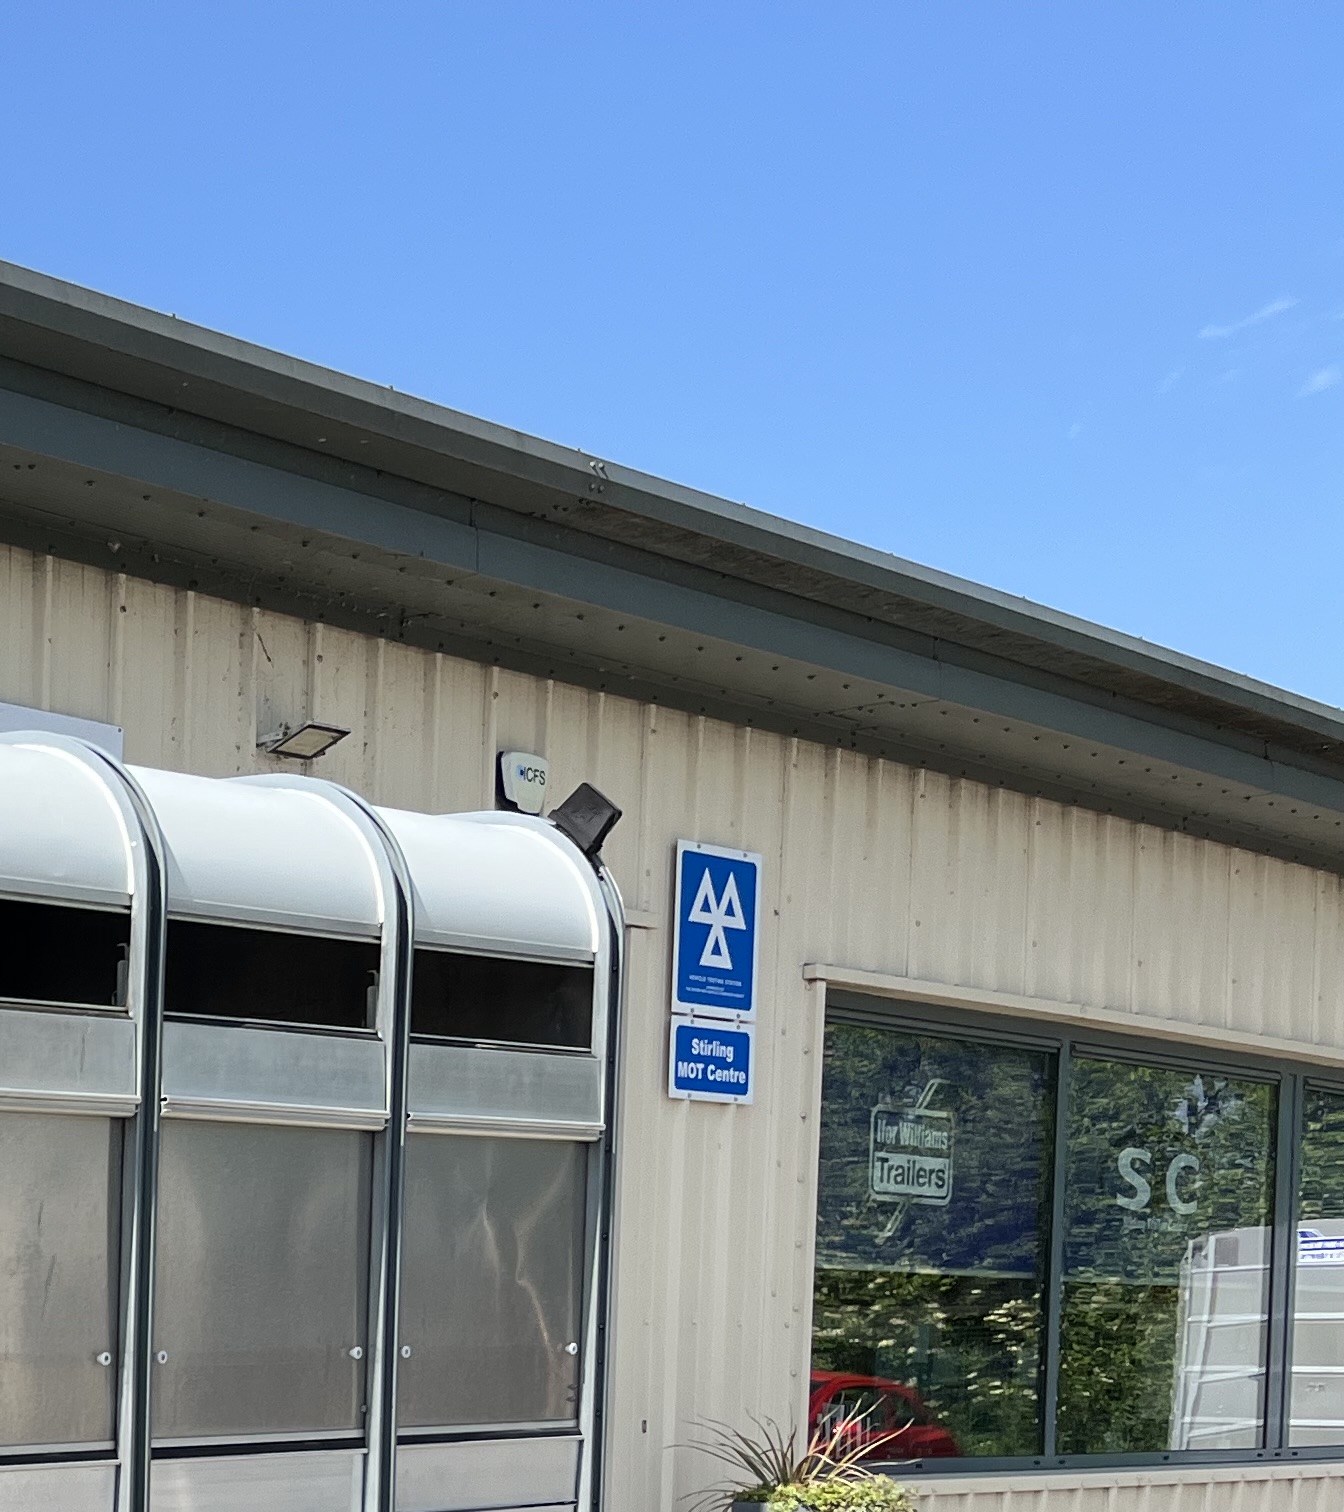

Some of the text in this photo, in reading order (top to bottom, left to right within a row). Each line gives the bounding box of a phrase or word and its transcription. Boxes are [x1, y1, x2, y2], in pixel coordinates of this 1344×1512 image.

[691, 1038, 734, 1062] Stirling
[677, 1061, 746, 1084] MOT Centre
[877, 1118, 948, 1150] Ifor Williams
[875, 1156, 946, 1189] Trailers
